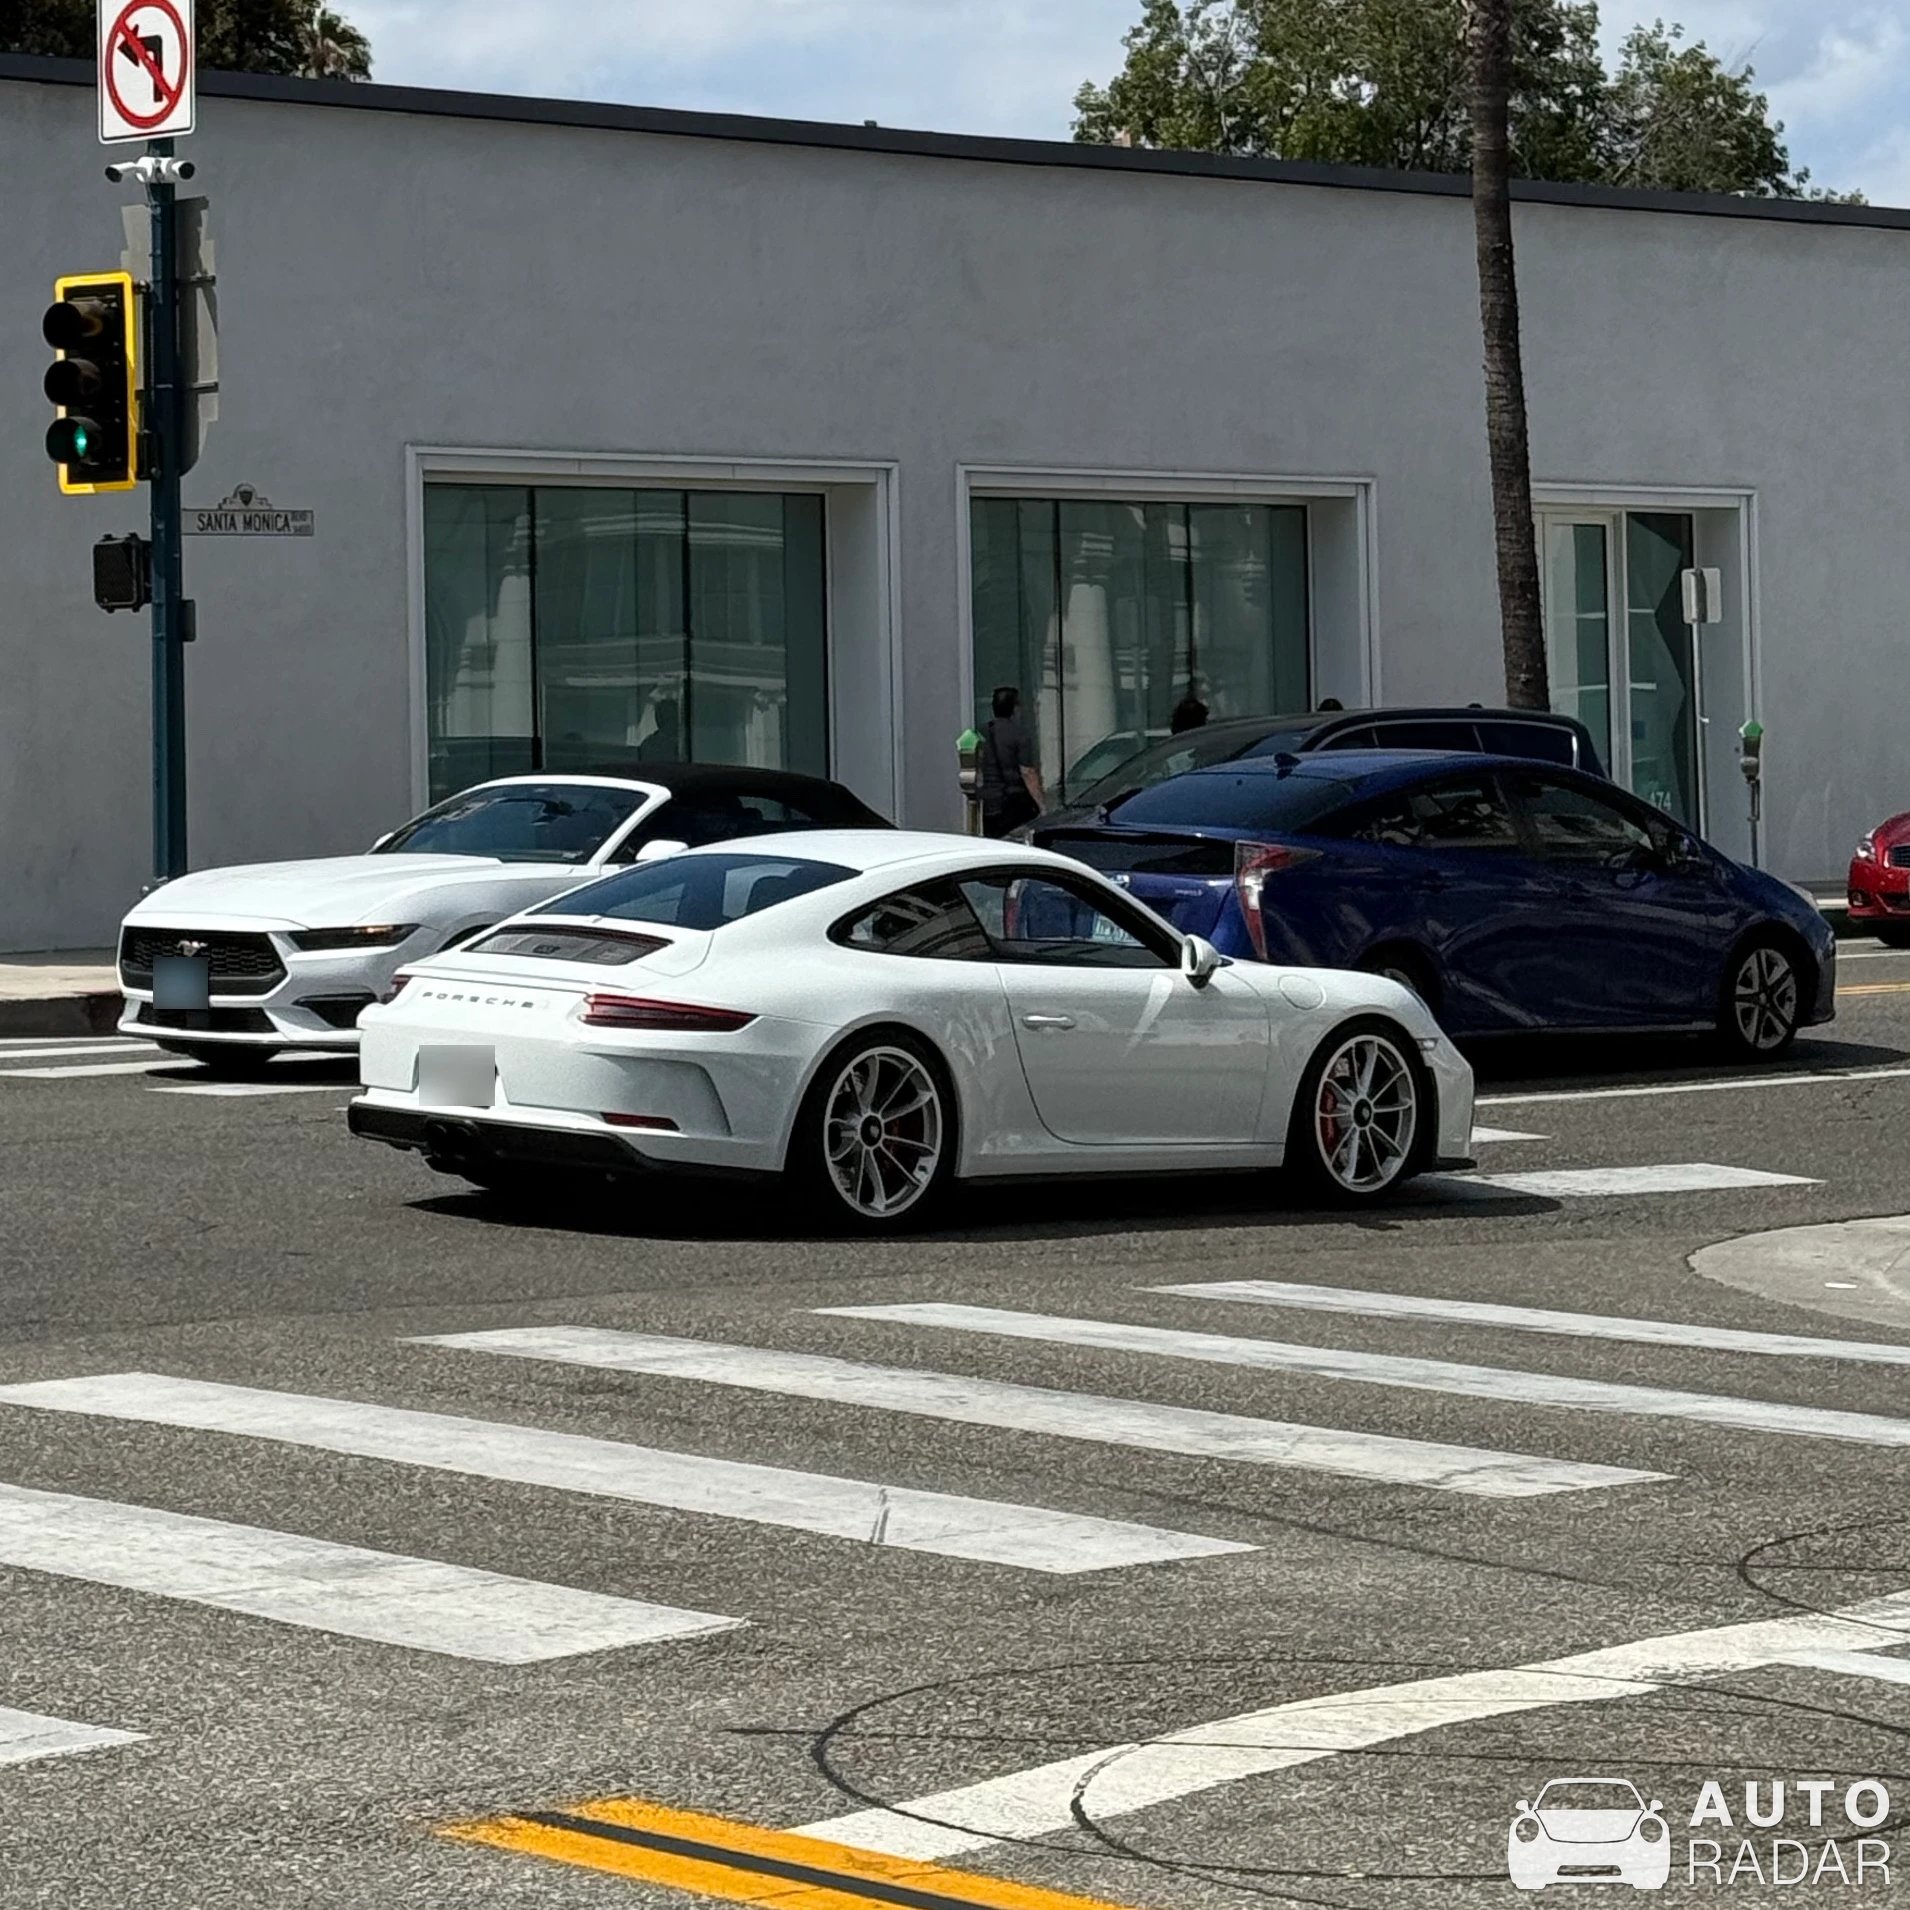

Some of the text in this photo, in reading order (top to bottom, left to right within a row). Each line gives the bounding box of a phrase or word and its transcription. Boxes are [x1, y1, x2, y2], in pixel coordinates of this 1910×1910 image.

[197, 513, 238, 532] SANTA
[243, 513, 291, 532] MONICA
[422, 991, 534, 1008] PORSCHE
